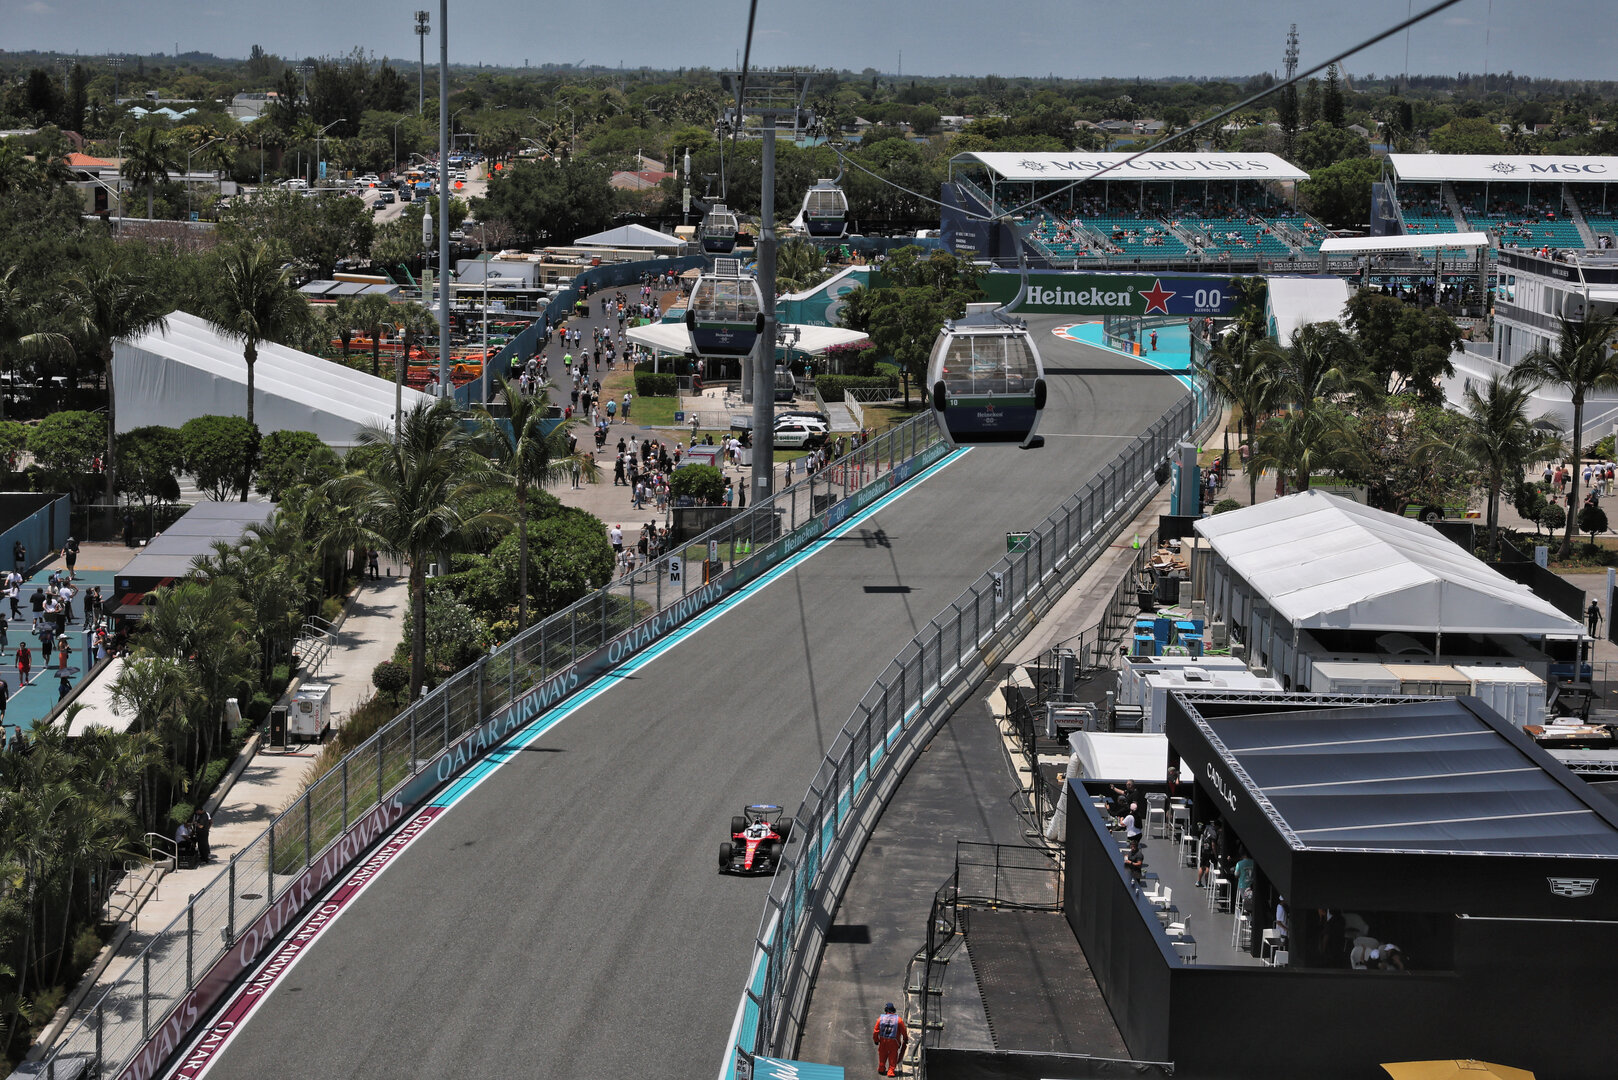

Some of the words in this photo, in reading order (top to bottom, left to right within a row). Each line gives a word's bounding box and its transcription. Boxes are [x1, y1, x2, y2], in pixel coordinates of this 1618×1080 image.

[1049, 160, 1120, 171] MSC
[1124, 160, 1269, 172] CRUISES
[1527, 163, 1607, 174] MSC
[1194, 289, 1220, 308] 0.0
[858, 482, 886, 507] Heineken
[784, 524, 819, 554] Heineken
[608, 620, 661, 664] QATAR
[664, 578, 723, 630] AIRWAYS
[438, 718, 500, 782] QATAR
[504, 666, 578, 734] AIRWAYS
[1206, 762, 1236, 812] CADILLAC
[392, 816, 432, 844] QATAR
[240, 874, 312, 967] QATAR
[318, 791, 403, 890] AIRWAYS
[348, 846, 398, 887] AIRWAYS
[296, 904, 338, 941] QATAR
[246, 944, 300, 996] AIRWAYS
[183, 1021, 234, 1070] QATAR
